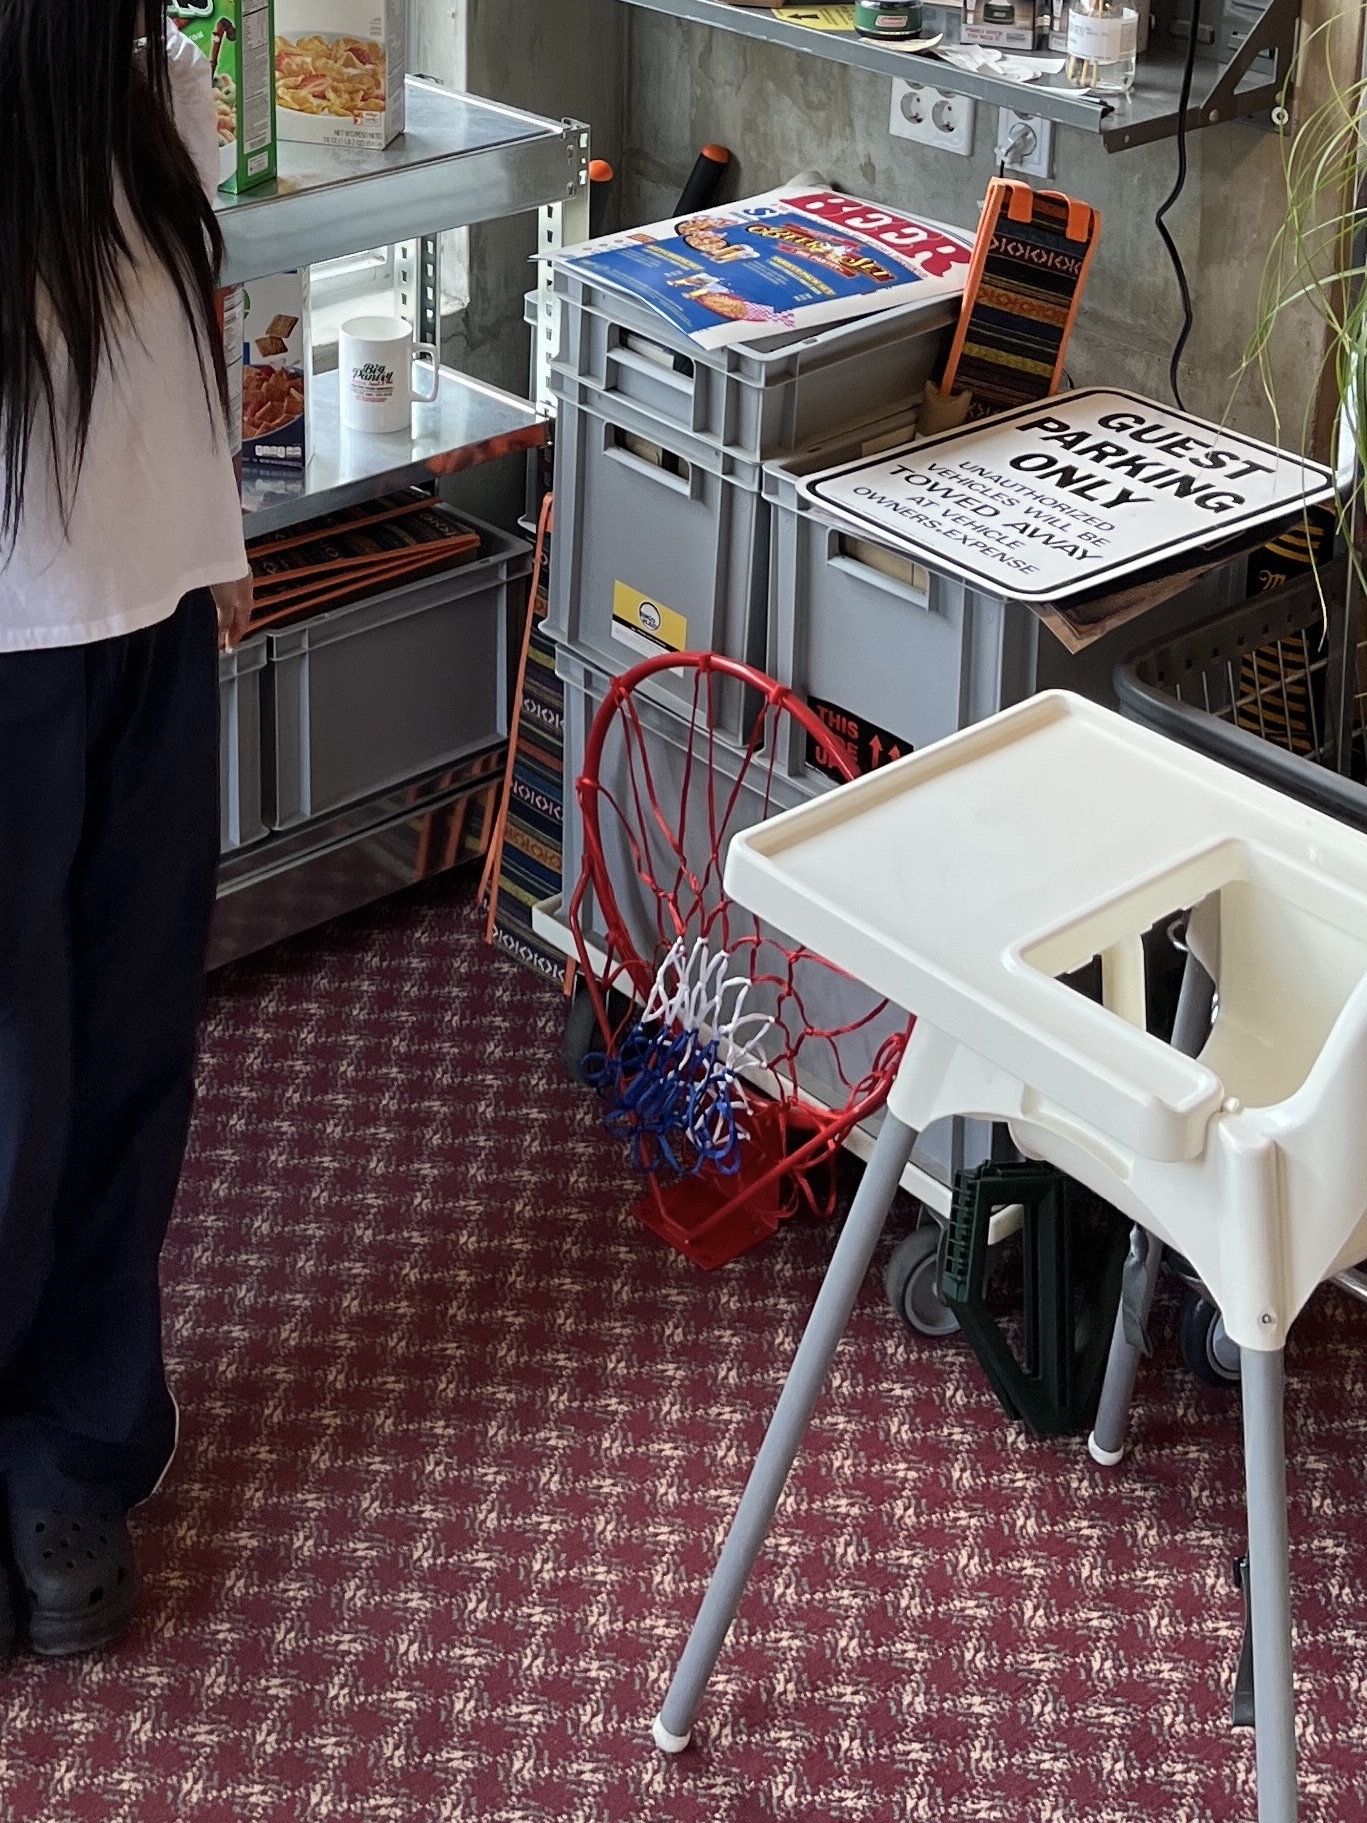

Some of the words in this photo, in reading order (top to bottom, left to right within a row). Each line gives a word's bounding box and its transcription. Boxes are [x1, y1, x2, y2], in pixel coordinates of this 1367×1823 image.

[779, 192, 971, 278] BEER
[352, 367, 394, 384] Pantry
[363, 362, 386, 374] Big
[1015, 416, 1247, 514] PARKING
[1097, 412, 1277, 480] GUEST
[889, 464, 1001, 518] TOWED
[1002, 521, 1104, 562] AWAY
[927, 462, 1021, 507] VEHICLES
[1023, 505, 1076, 533] WILL
[1077, 531, 1112, 548] BE
[958, 461, 1116, 532] UNAUTHORIZED
[1009, 453, 1155, 509] ONLY
[905, 495, 940, 509] AT
[941, 508, 1027, 551] VEHICLE
[817, 705, 859, 740] THIS
